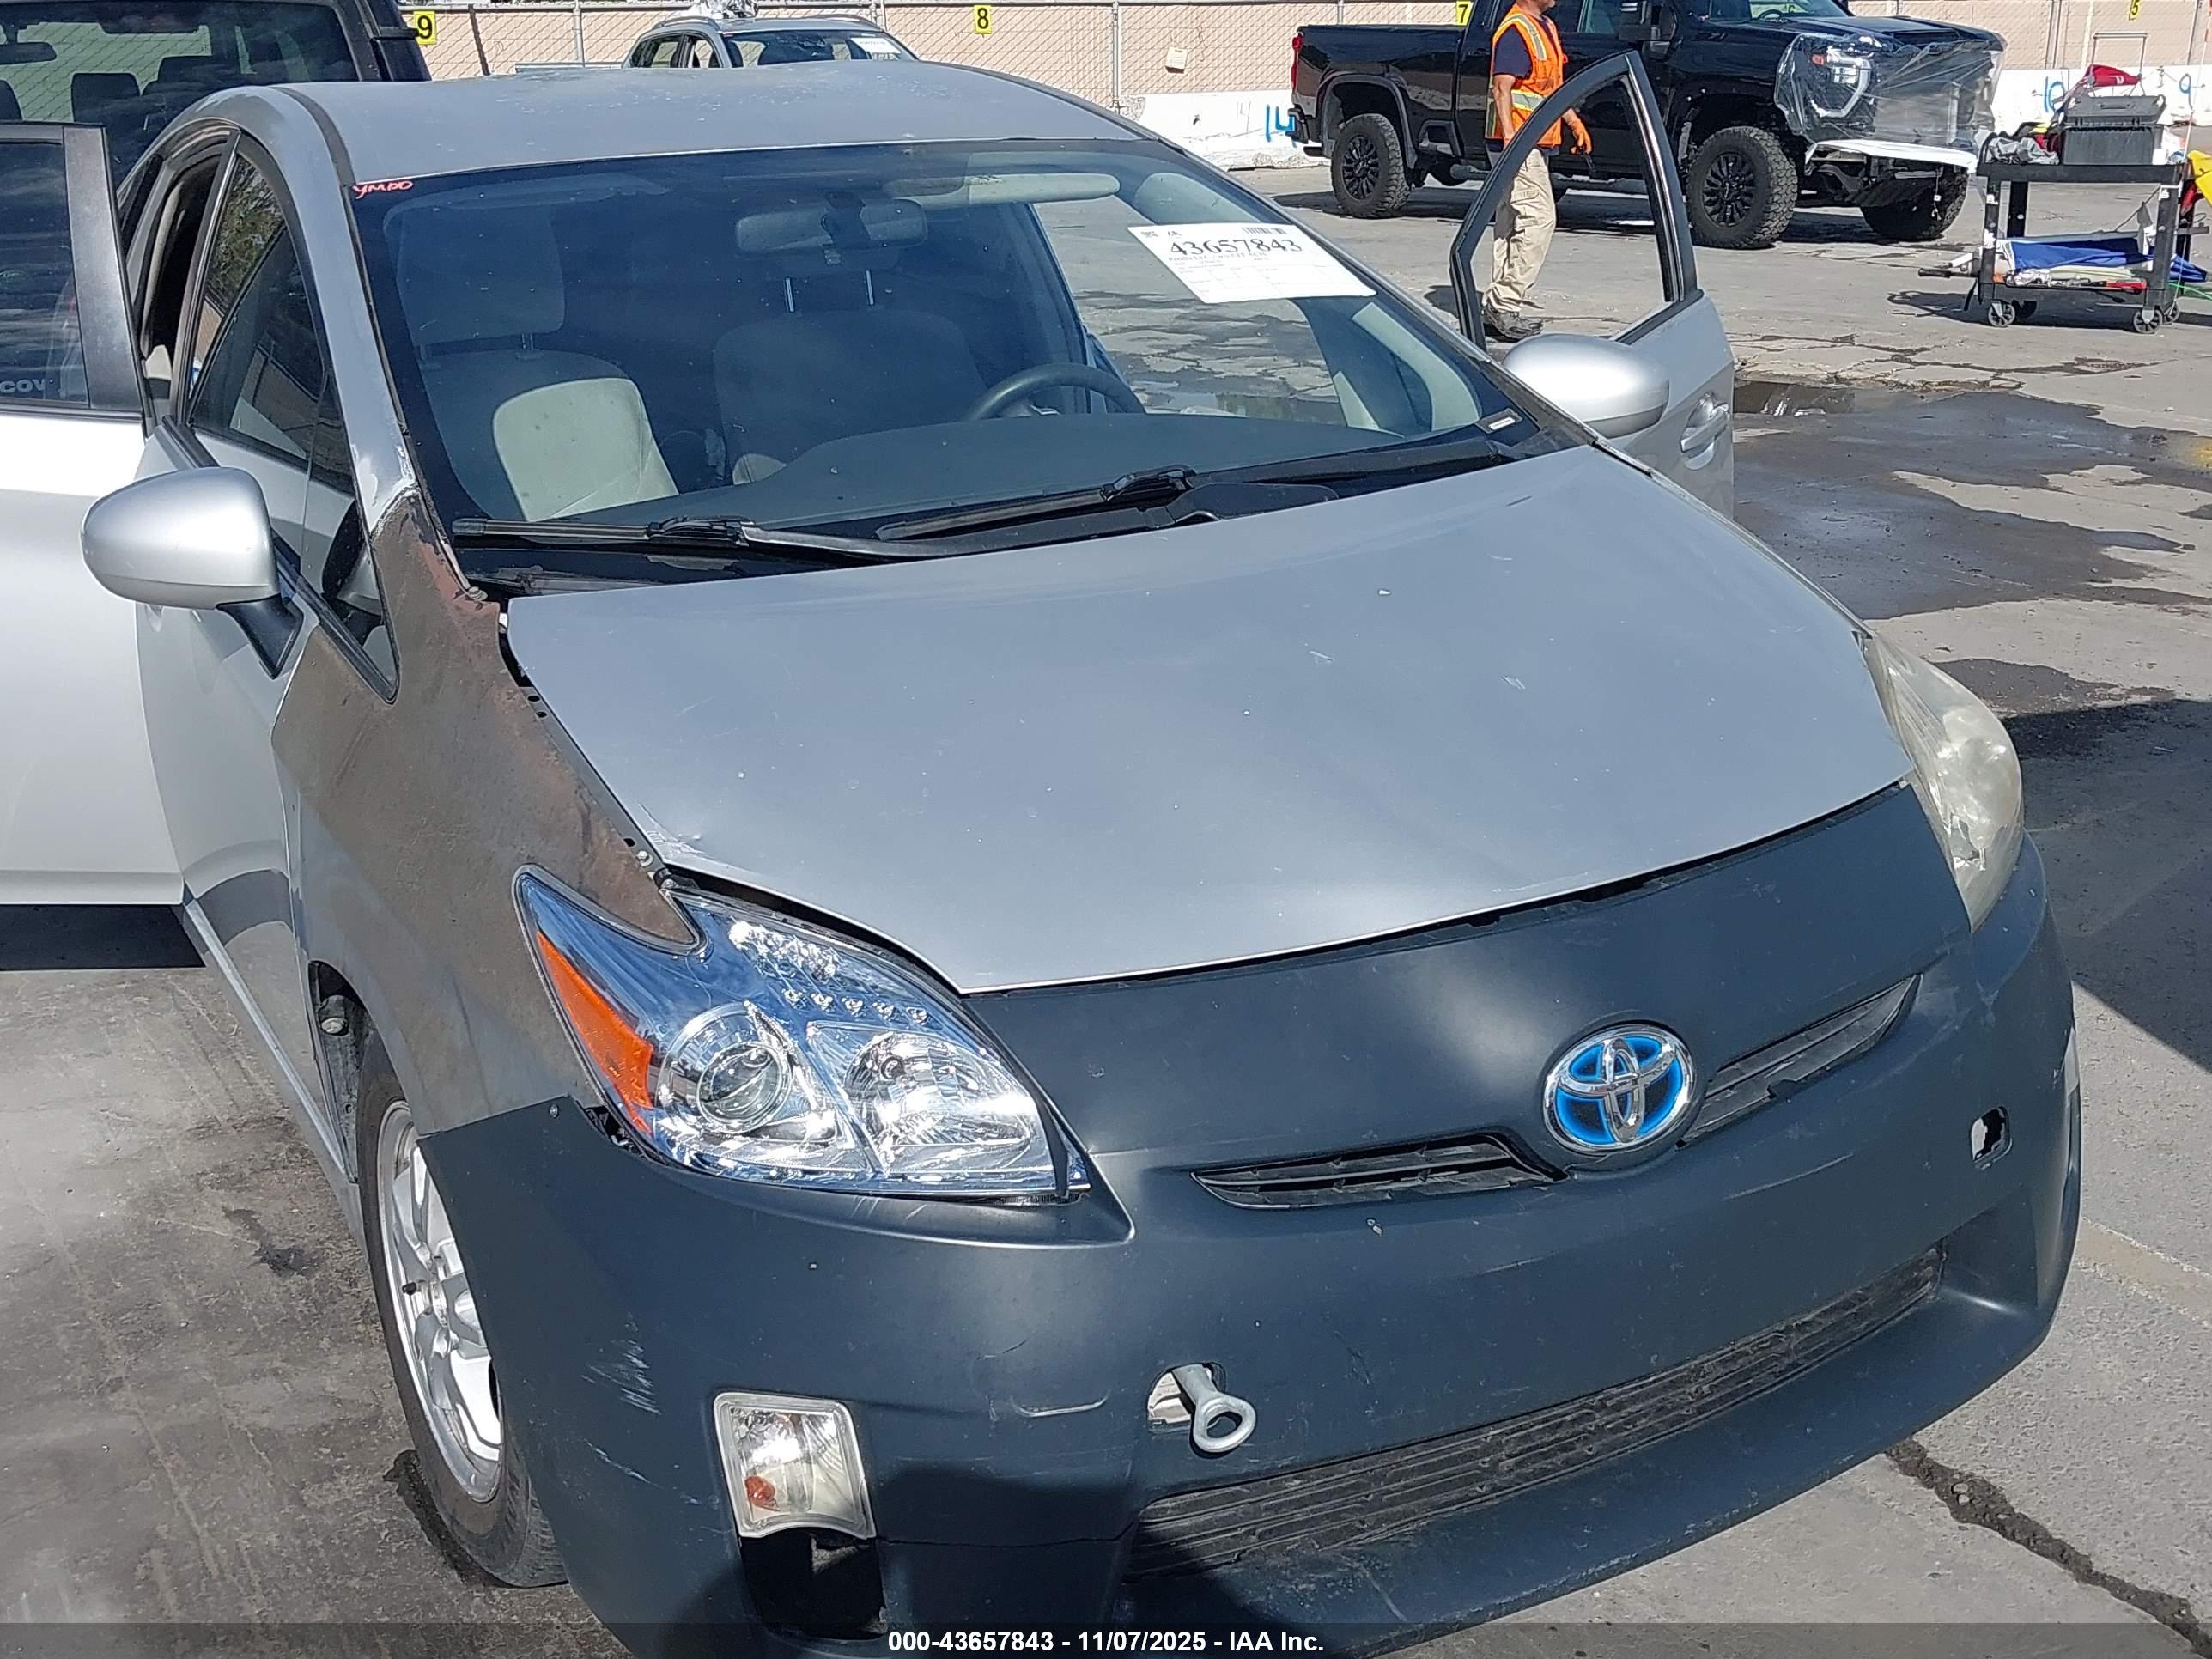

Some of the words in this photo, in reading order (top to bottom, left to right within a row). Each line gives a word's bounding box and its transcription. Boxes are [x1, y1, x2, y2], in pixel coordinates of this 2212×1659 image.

[977, 7, 989, 29] 8
[1458, 3, 1468, 24] 7
[417, 15, 433, 40] 9
[1265, 103, 1297, 148] 14
[1170, 238, 1303, 256] 43657843
